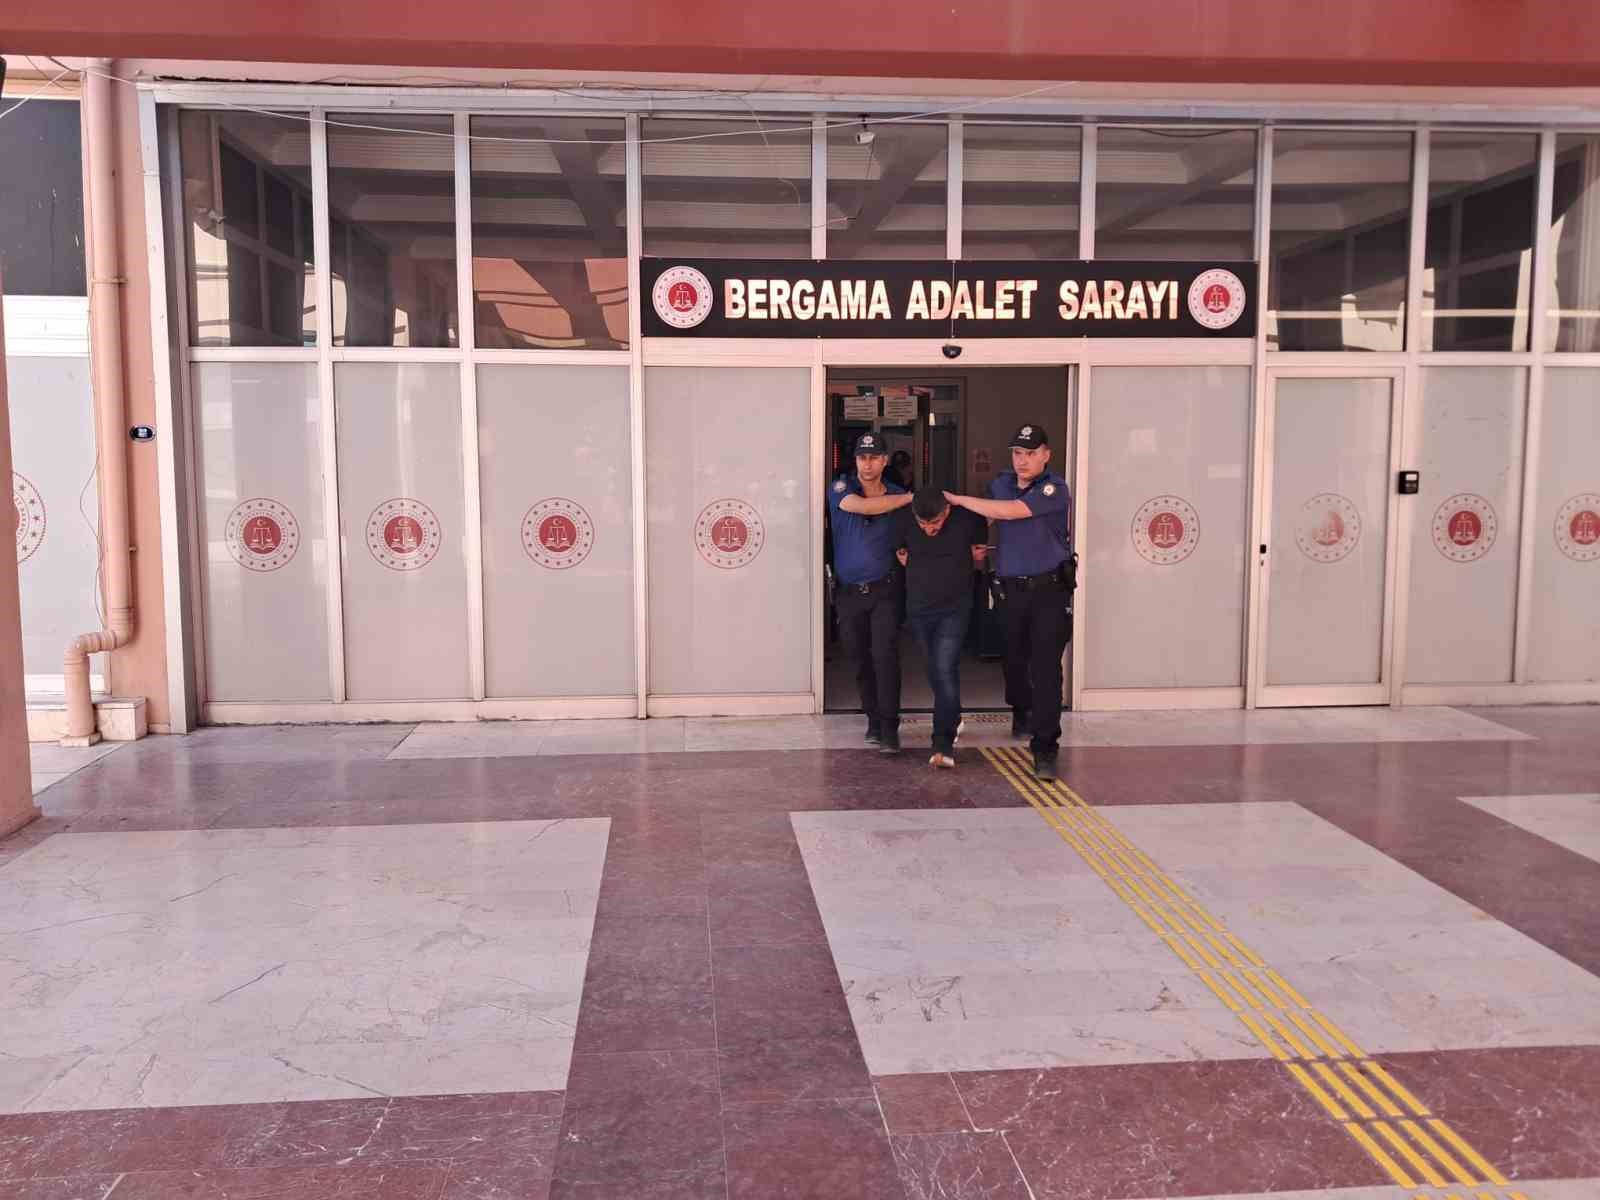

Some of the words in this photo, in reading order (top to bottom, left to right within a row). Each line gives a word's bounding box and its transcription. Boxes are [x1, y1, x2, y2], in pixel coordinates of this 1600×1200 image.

[724, 278, 892, 321] BERGAMA
[905, 279, 1038, 320] ADALET
[1058, 279, 1179, 321] SARAYI
